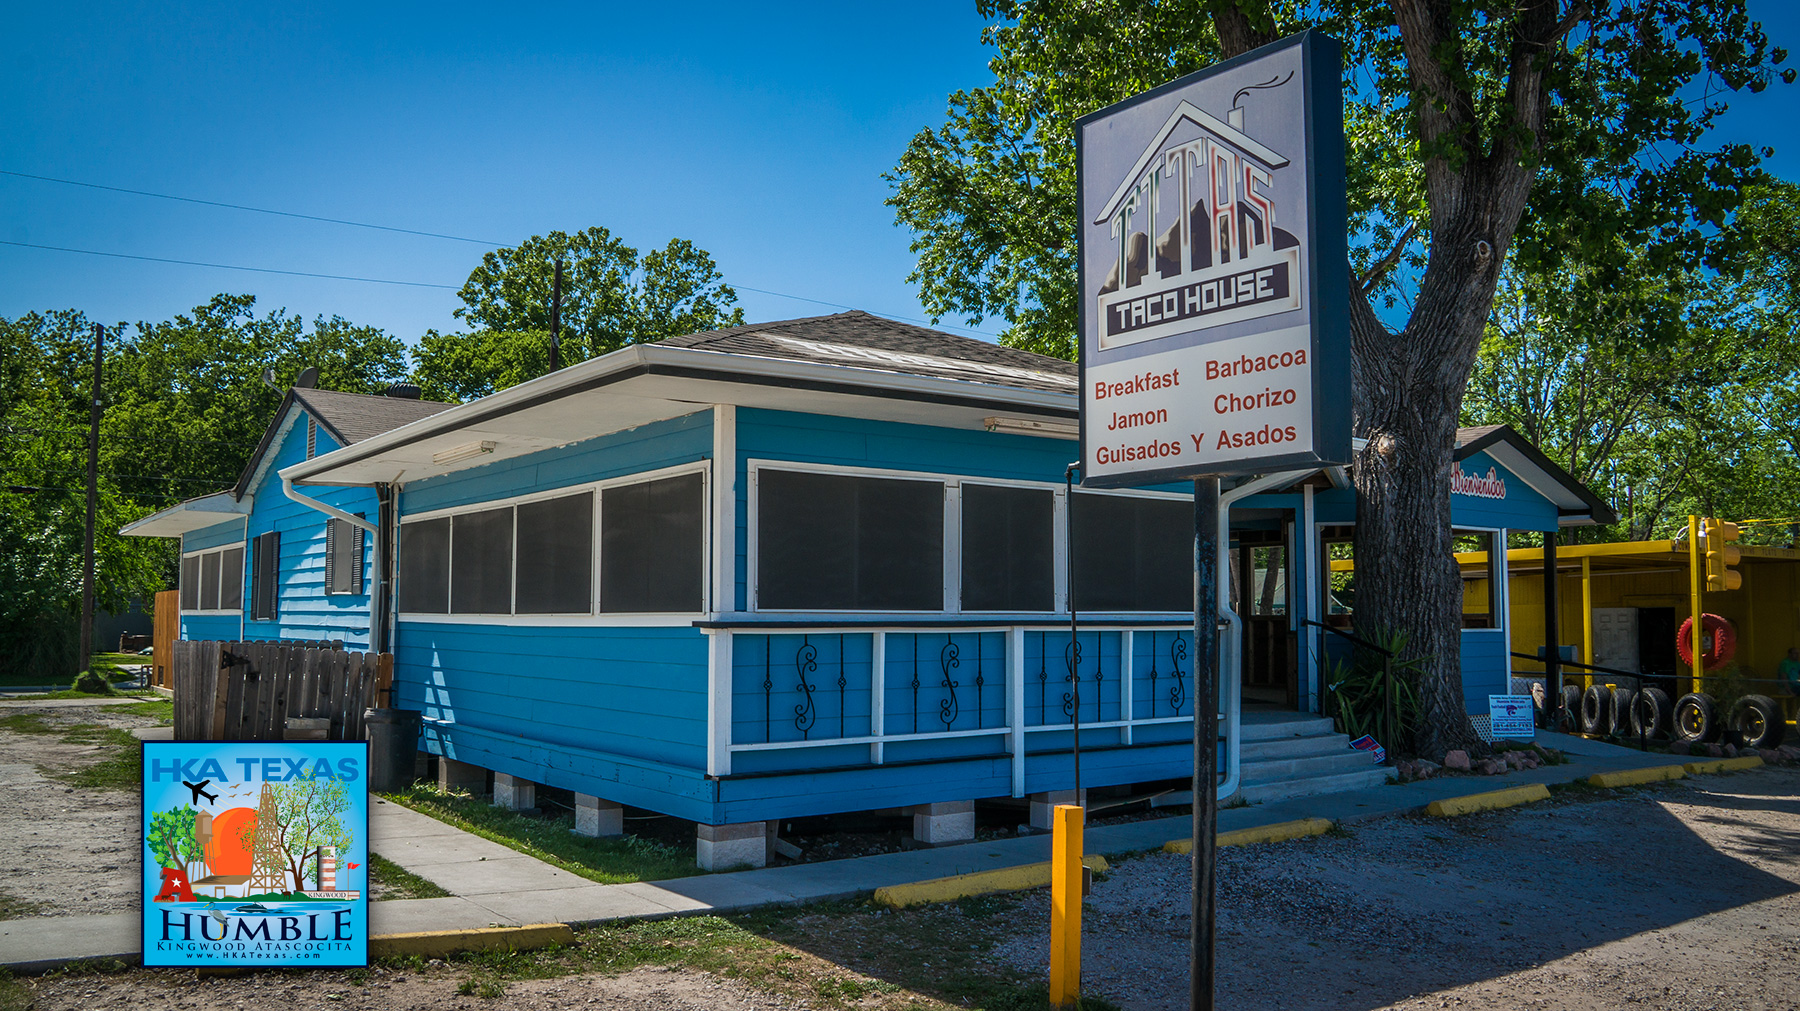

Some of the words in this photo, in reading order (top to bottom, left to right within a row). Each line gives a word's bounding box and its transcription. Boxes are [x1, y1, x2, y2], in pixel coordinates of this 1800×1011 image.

[1115, 290, 1178, 330] TACO
[1184, 268, 1274, 315] HOUSE
[1205, 348, 1307, 381] Barbacoa
[1095, 367, 1180, 401] Breakfast
[1213, 387, 1297, 415] Chorizo
[1107, 408, 1168, 431] Jamon
[1096, 439, 1182, 465] Guisados
[1190, 433, 1205, 453] Y
[1216, 424, 1297, 450] Asados
